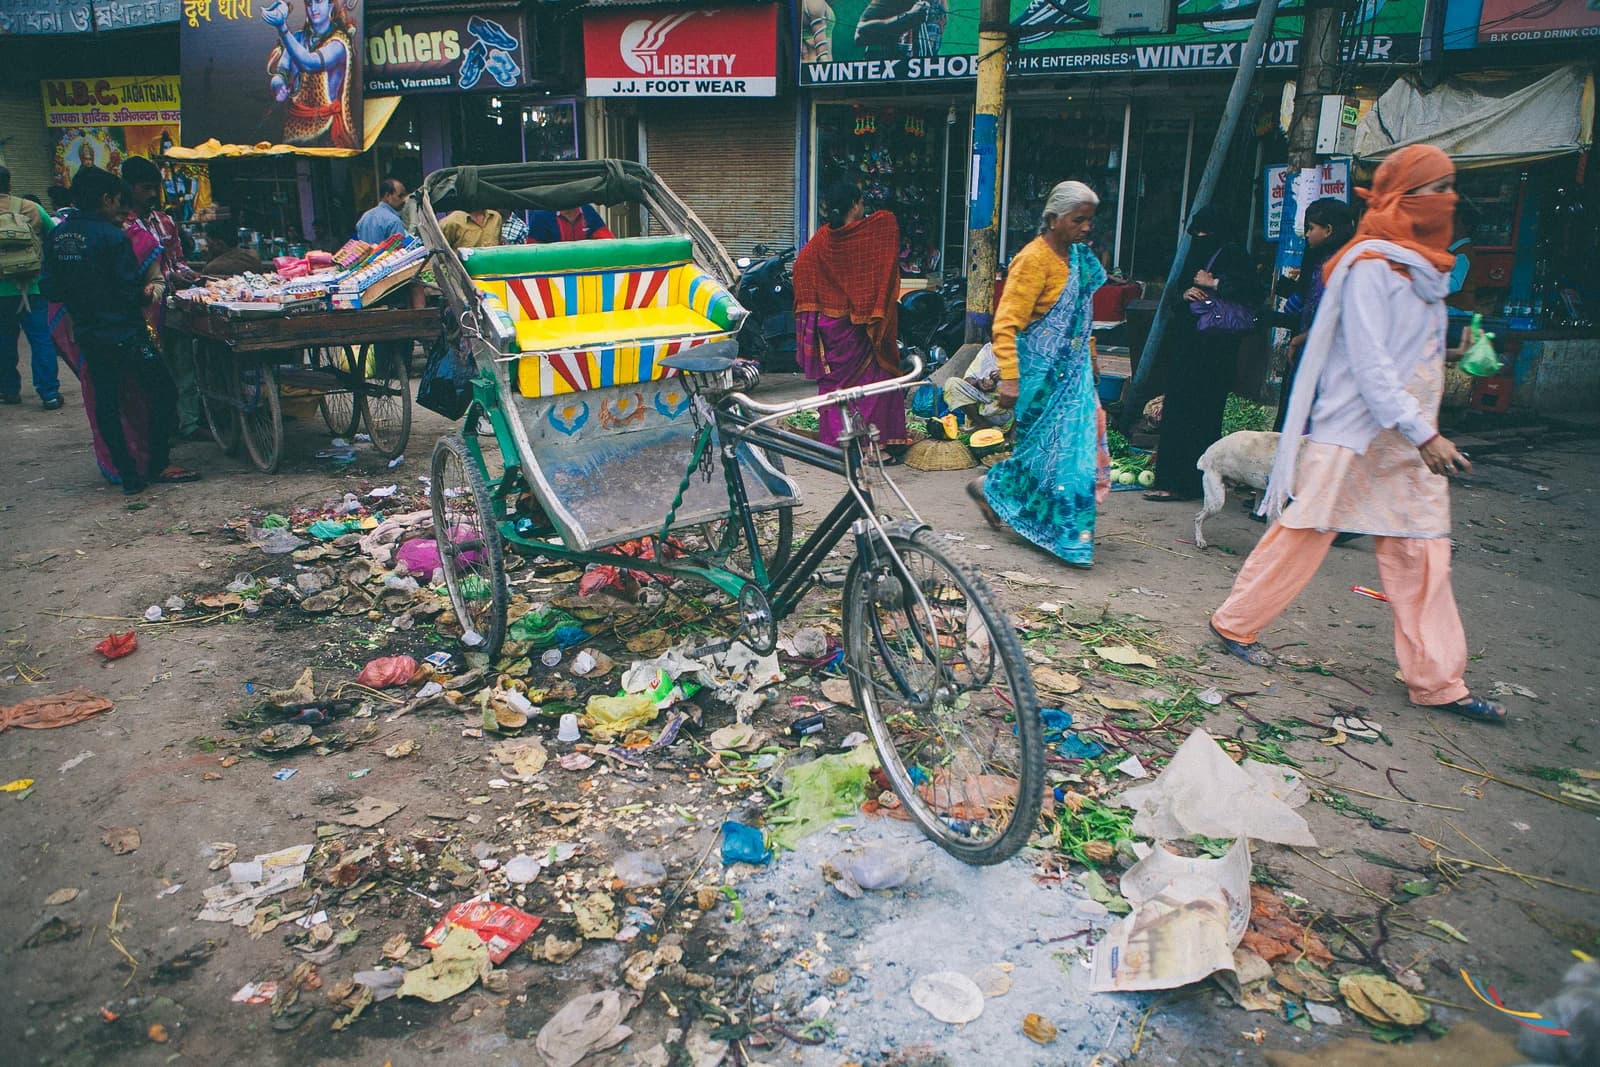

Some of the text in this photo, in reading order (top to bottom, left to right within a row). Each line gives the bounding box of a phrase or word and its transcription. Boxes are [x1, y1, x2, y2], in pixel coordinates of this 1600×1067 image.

[1511, 31, 1541, 41] COLD
[1544, 29, 1578, 39] DRINK
[652, 54, 736, 75] LIBERTY
[808, 59, 900, 82] WINTEX
[1136, 43, 1238, 68] WINTEX
[369, 75, 451, 91] Ghat, Varanasi
[612, 80, 746, 94] J.J. FOOT WEAR
[50, 111, 80, 125] आपका
